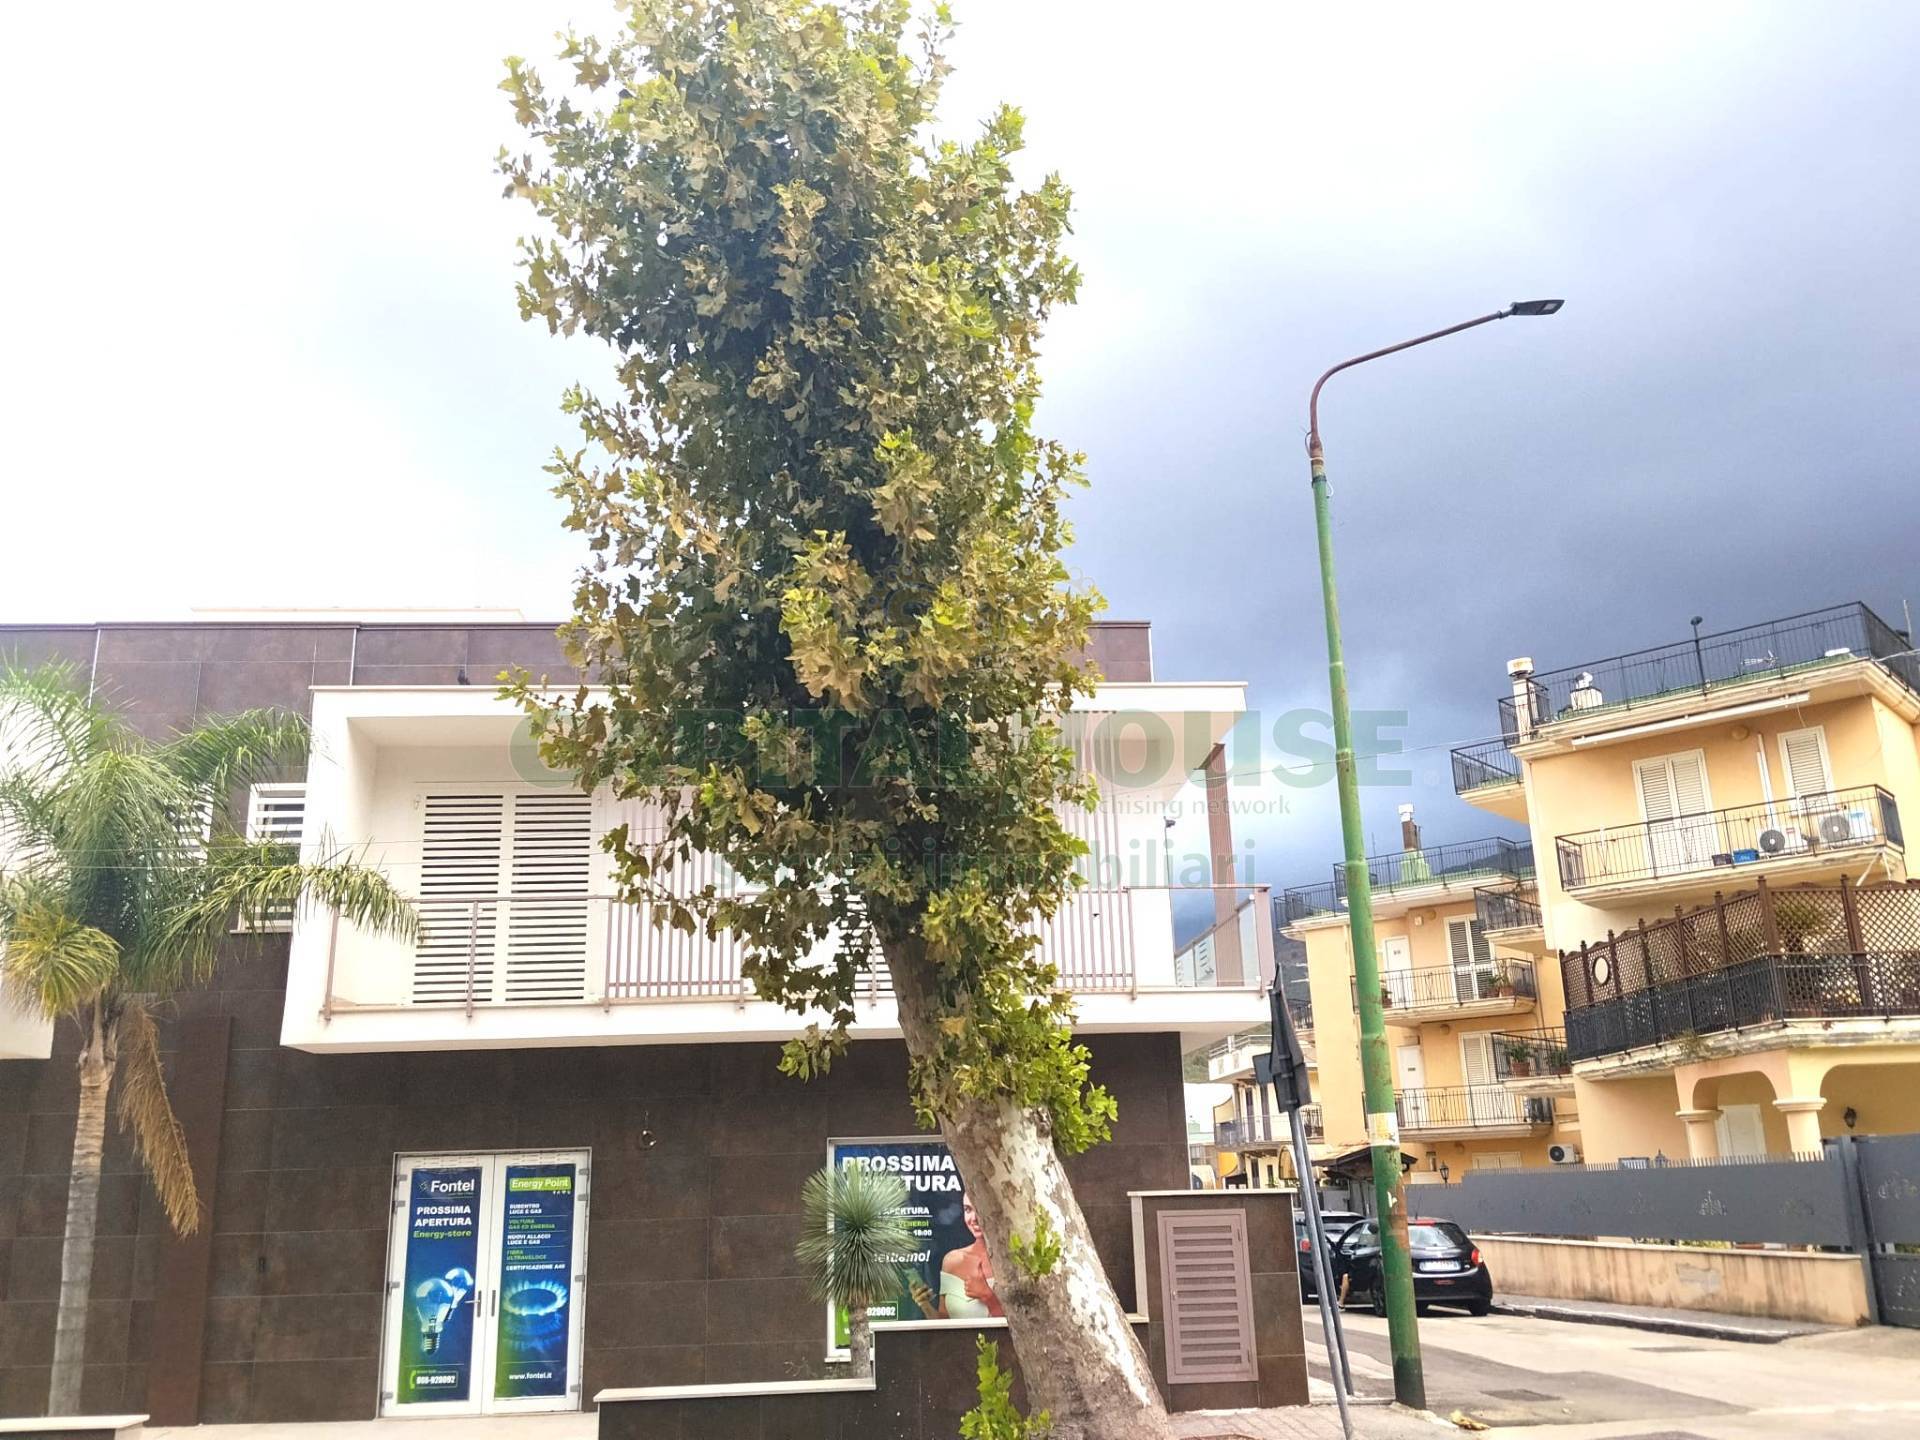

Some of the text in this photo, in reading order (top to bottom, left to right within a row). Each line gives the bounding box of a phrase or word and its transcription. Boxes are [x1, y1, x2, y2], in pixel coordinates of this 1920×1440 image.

[842, 1154, 956, 1173] PROSSIMA
[430, 1178, 475, 1193] Fontel
[511, 1177, 569, 1190] Energy Point
[416, 1204, 471, 1215] PROSSIMA
[414, 1216, 472, 1227] APERTURA
[413, 1229, 472, 1239] Energy-store
